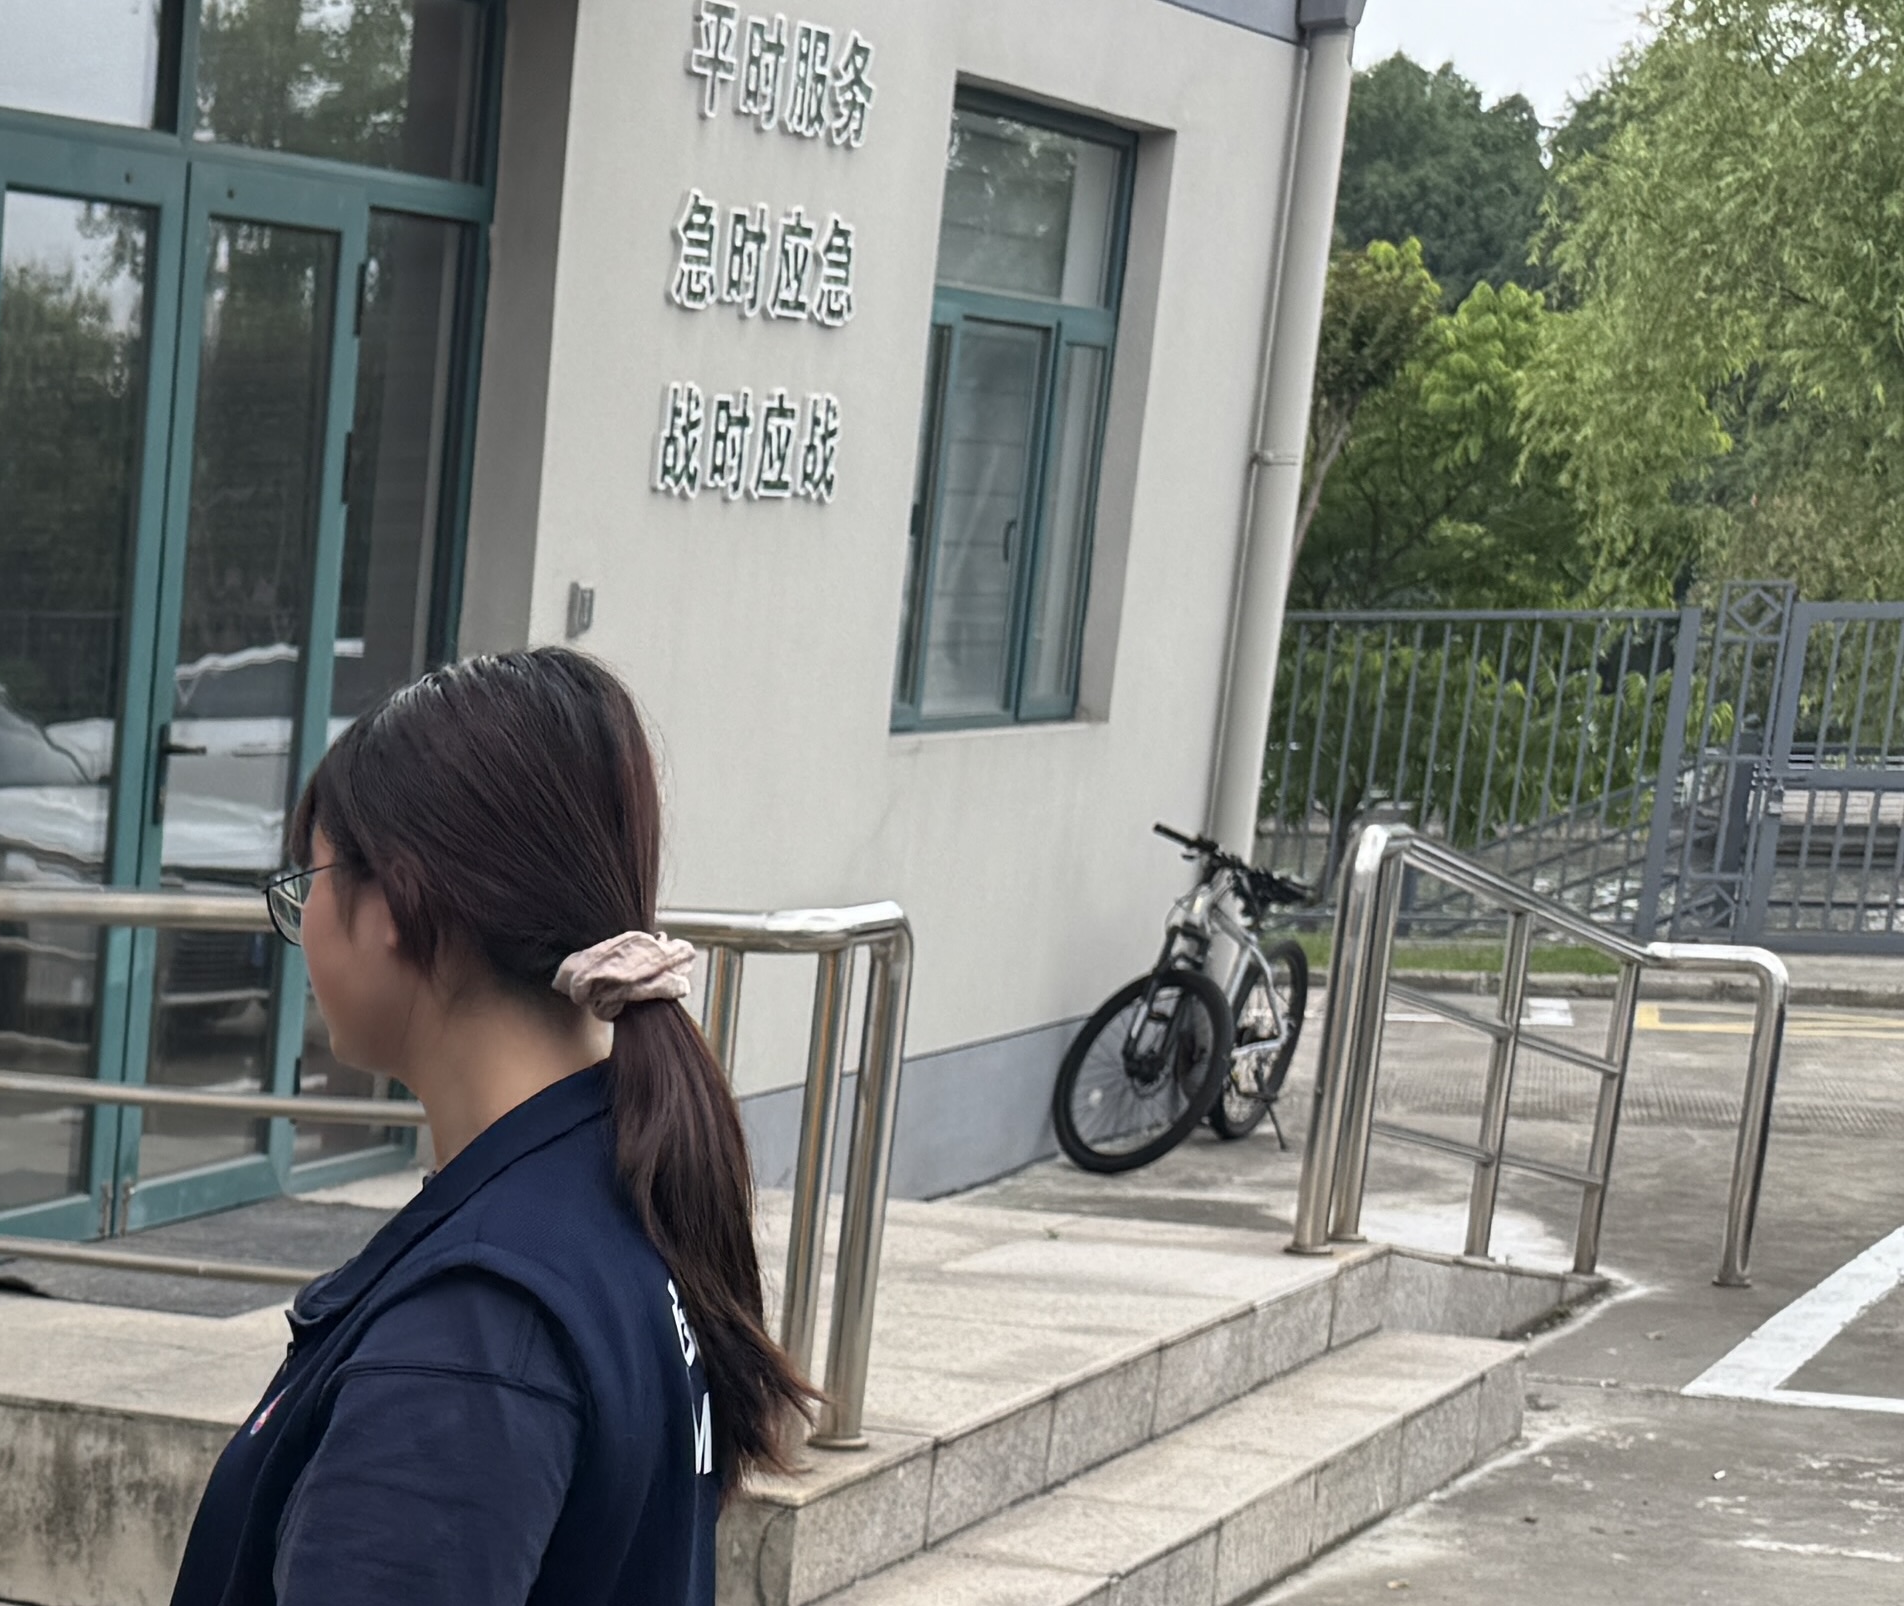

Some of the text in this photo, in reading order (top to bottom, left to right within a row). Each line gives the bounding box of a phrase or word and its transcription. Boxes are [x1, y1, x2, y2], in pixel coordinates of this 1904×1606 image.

[690, 0, 876, 147] 平时服务
[669, 188, 856, 326] 急时应急
[653, 381, 841, 504] 战时应战
